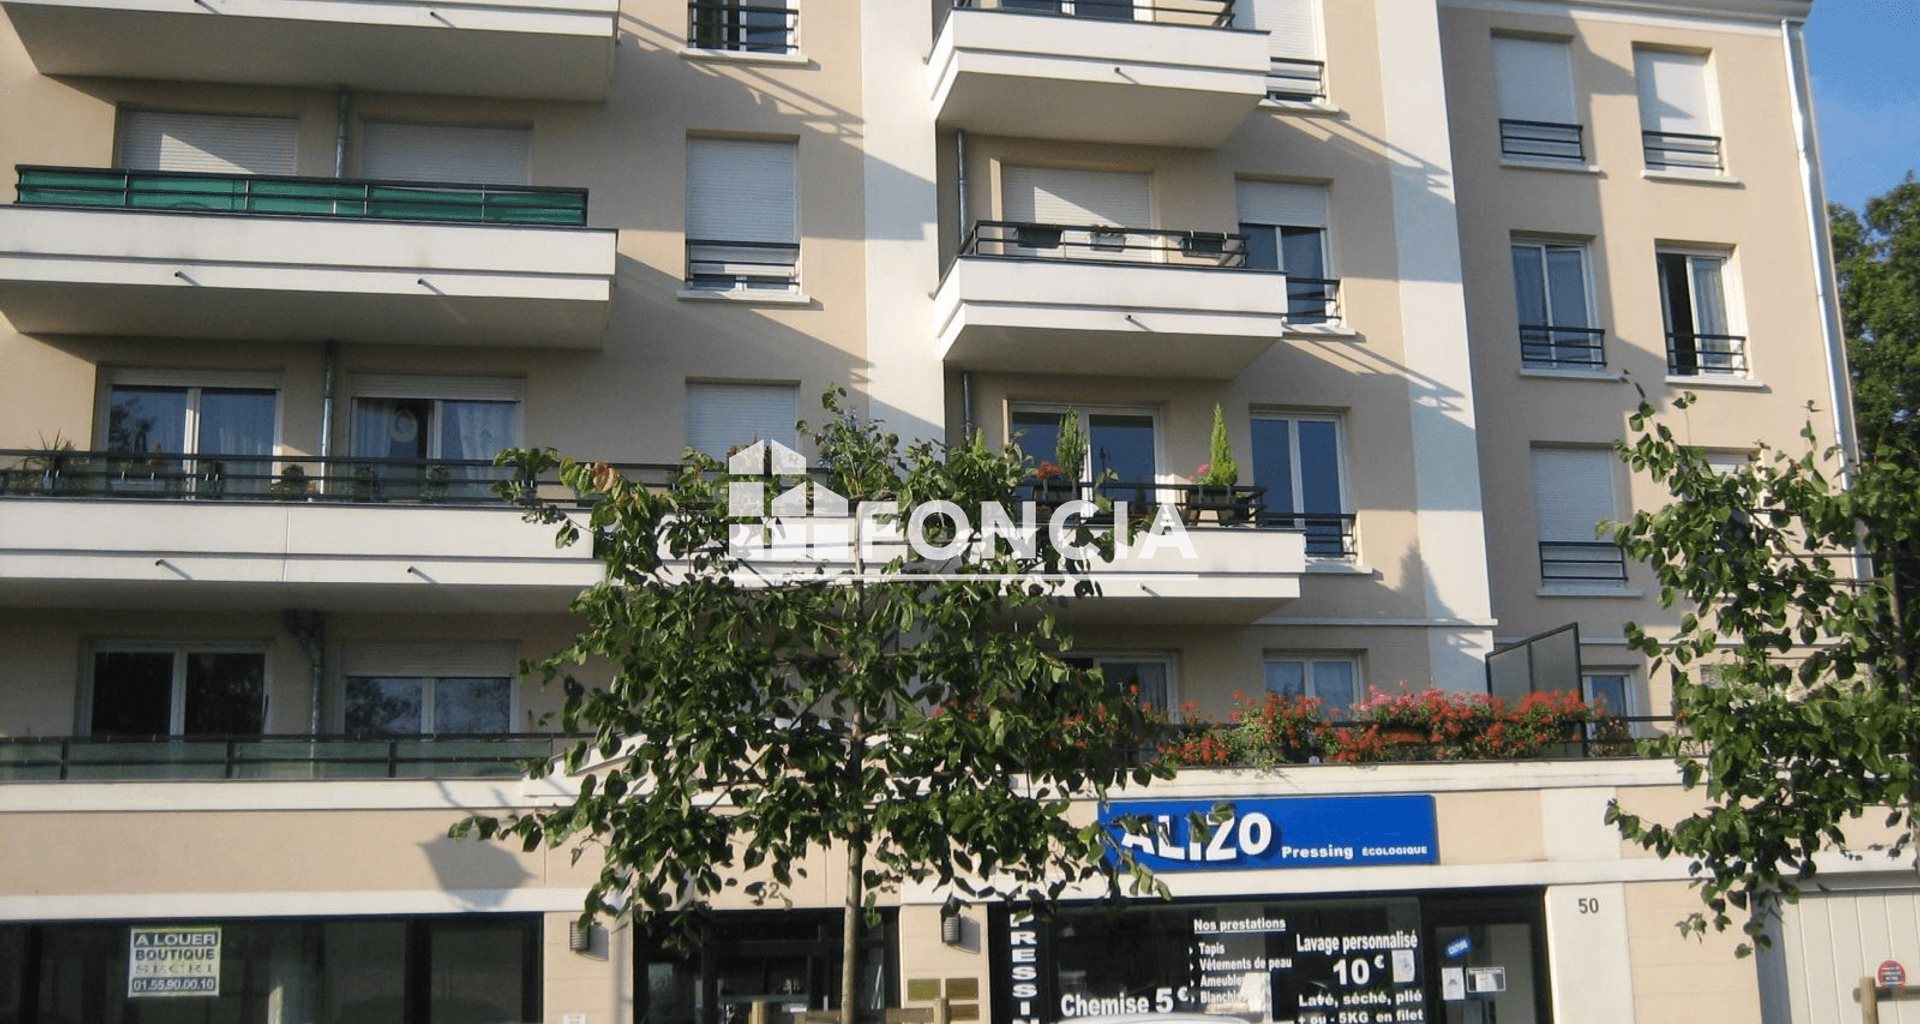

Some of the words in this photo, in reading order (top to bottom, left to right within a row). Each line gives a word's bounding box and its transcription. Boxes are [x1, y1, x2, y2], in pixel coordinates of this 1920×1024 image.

[1281, 844, 1354, 860] Pressing
[1578, 897, 1599, 914] 50
[1193, 918, 1217, 932] Nos
[1220, 917, 1286, 933] prestations
[135, 933, 149, 946] A
[153, 933, 216, 946] LOUER
[1296, 933, 1339, 955] Lavage
[1342, 929, 1418, 954] personnalisé
[135, 948, 215, 961] BOUTIQUE
[1198, 941, 1225, 957] Tapis
[1199, 957, 1252, 971] Vêtements
[1254, 956, 1266, 969] de
[1268, 958, 1292, 971] peau
[133, 979, 214, 991] 01.55.90.00.10
[1060, 991, 1149, 1017] Chemise
[1298, 993, 1339, 1008] Lavé,
[1395, 988, 1422, 1006] plié
[1310, 1015, 1327, 1024] ou
[1338, 1011, 1369, 1024] 5KG
[1376, 1012, 1393, 1023] en
[1396, 1008, 1423, 1021] filet
